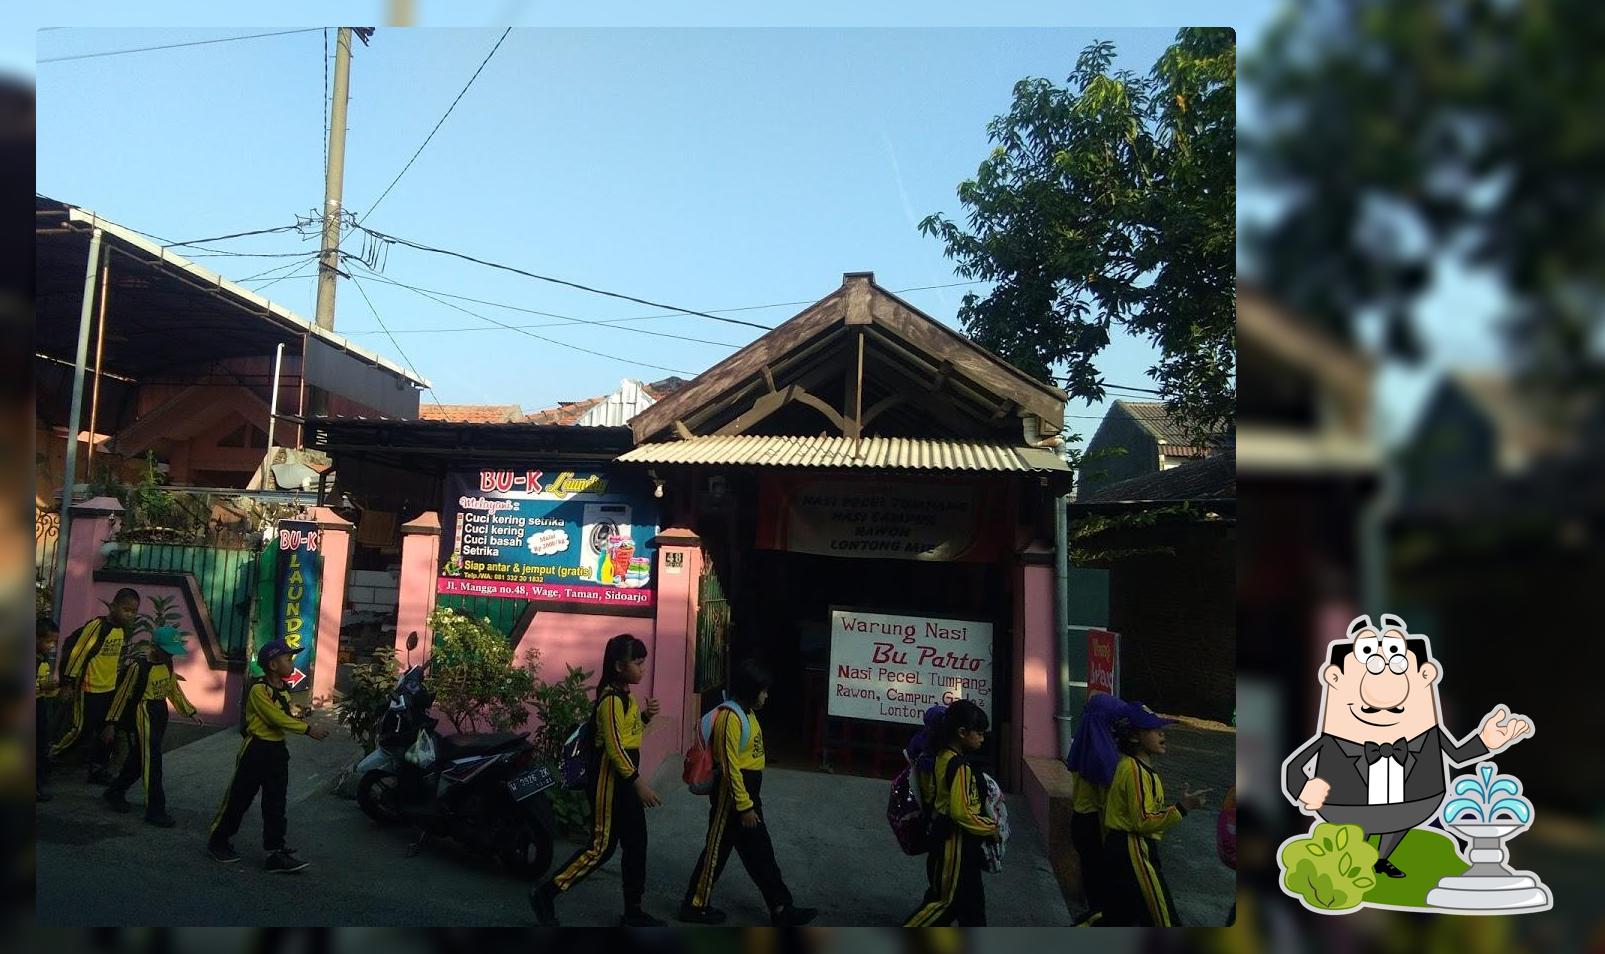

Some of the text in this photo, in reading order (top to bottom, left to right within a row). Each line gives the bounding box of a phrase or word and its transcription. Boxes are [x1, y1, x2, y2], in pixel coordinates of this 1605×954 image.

[480, 469, 543, 493] BU-K
[465, 513, 565, 527] Cuci kering setrika
[465, 524, 524, 537] Cuci kering
[280, 530, 318, 551] BU-K
[464, 535, 522, 547] Cuci basah
[831, 540, 899, 551] LONTONG
[463, 545, 499, 556] Setrika
[667, 553, 681, 562] 48
[465, 560, 592, 577] Siap antar & jemput (gratis)
[461, 583, 497, 595] Mangga
[500, 585, 528, 595] no.48,
[532, 587, 561, 598] Wage,
[565, 589, 602, 600] Taman,
[605, 590, 647, 603] Sidoarjo
[842, 617, 967, 643] Warung Nasi
[872, 642, 984, 672] Bu Parto
[838, 665, 872, 679] Nasi
[837, 684, 880, 701] Rawon,
[887, 688, 938, 705] Campur,
